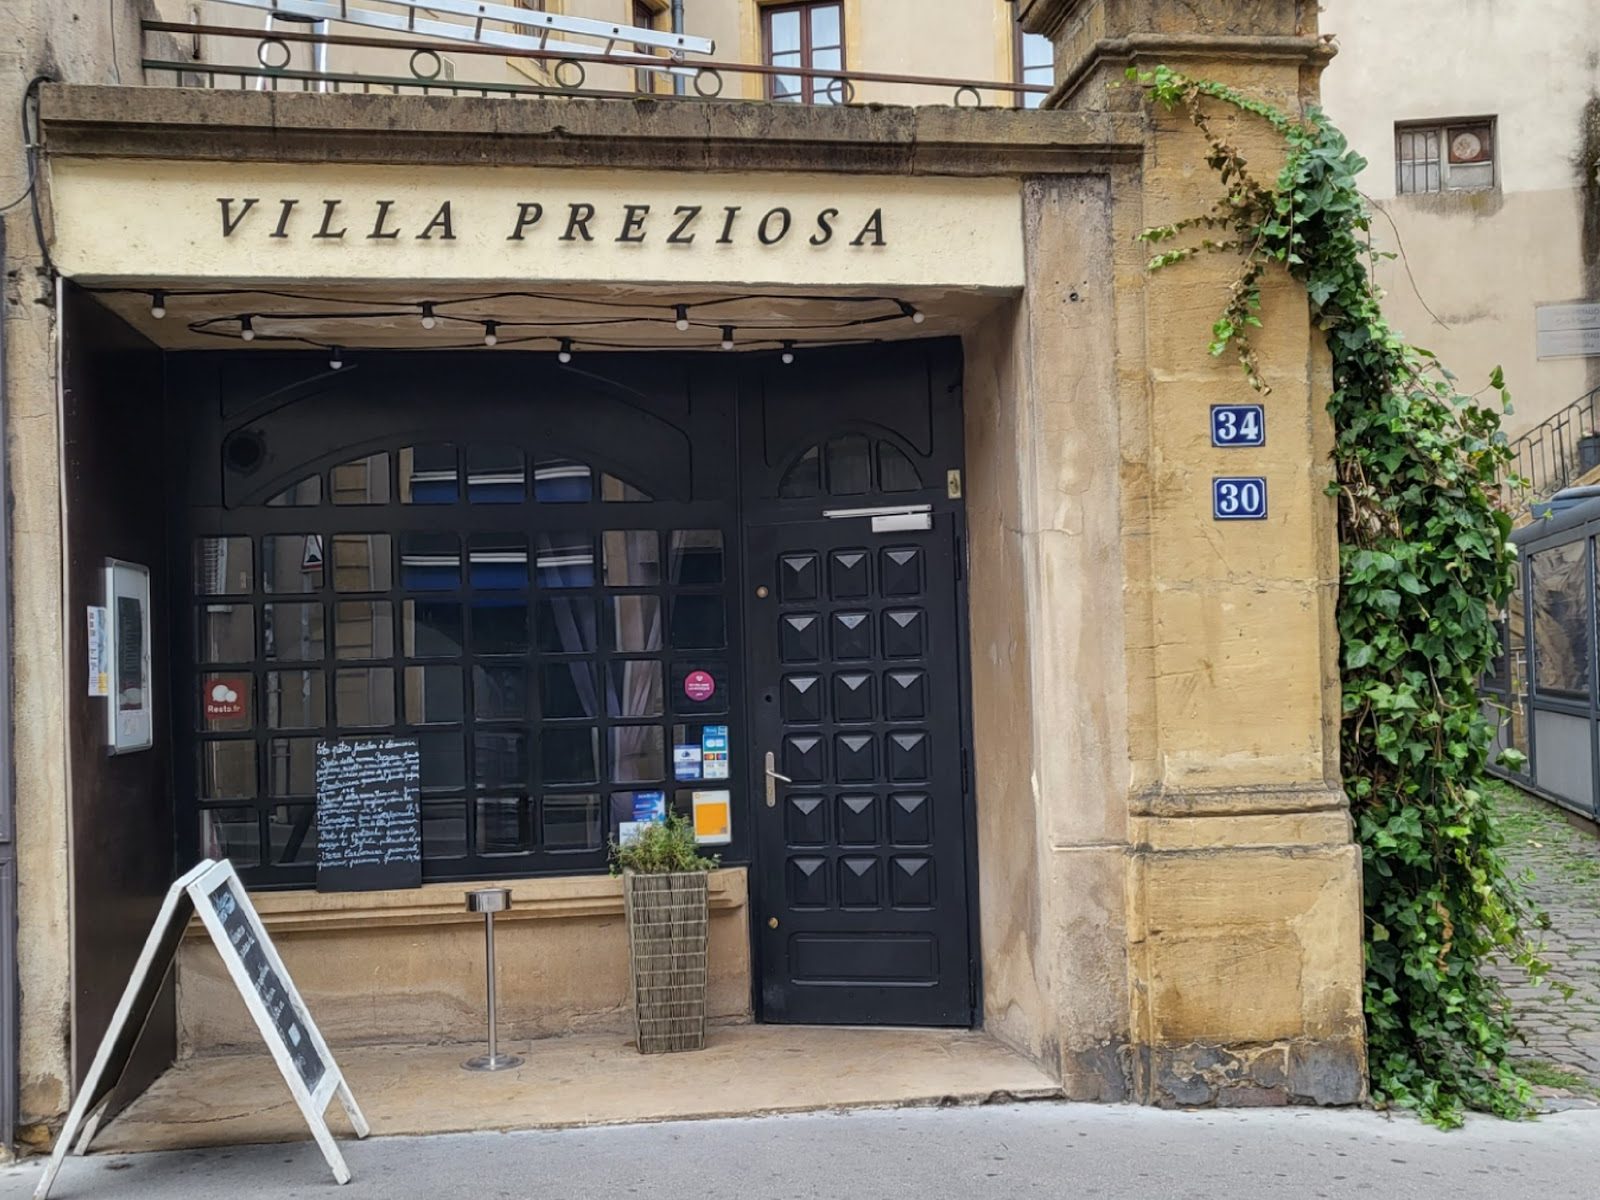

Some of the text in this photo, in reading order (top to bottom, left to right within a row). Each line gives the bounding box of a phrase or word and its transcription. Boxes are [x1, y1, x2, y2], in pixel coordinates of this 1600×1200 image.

[216, 198, 887, 246] VILLA PREZIOSA
[1218, 411, 1259, 440] 34
[1220, 483, 1260, 512] 30
